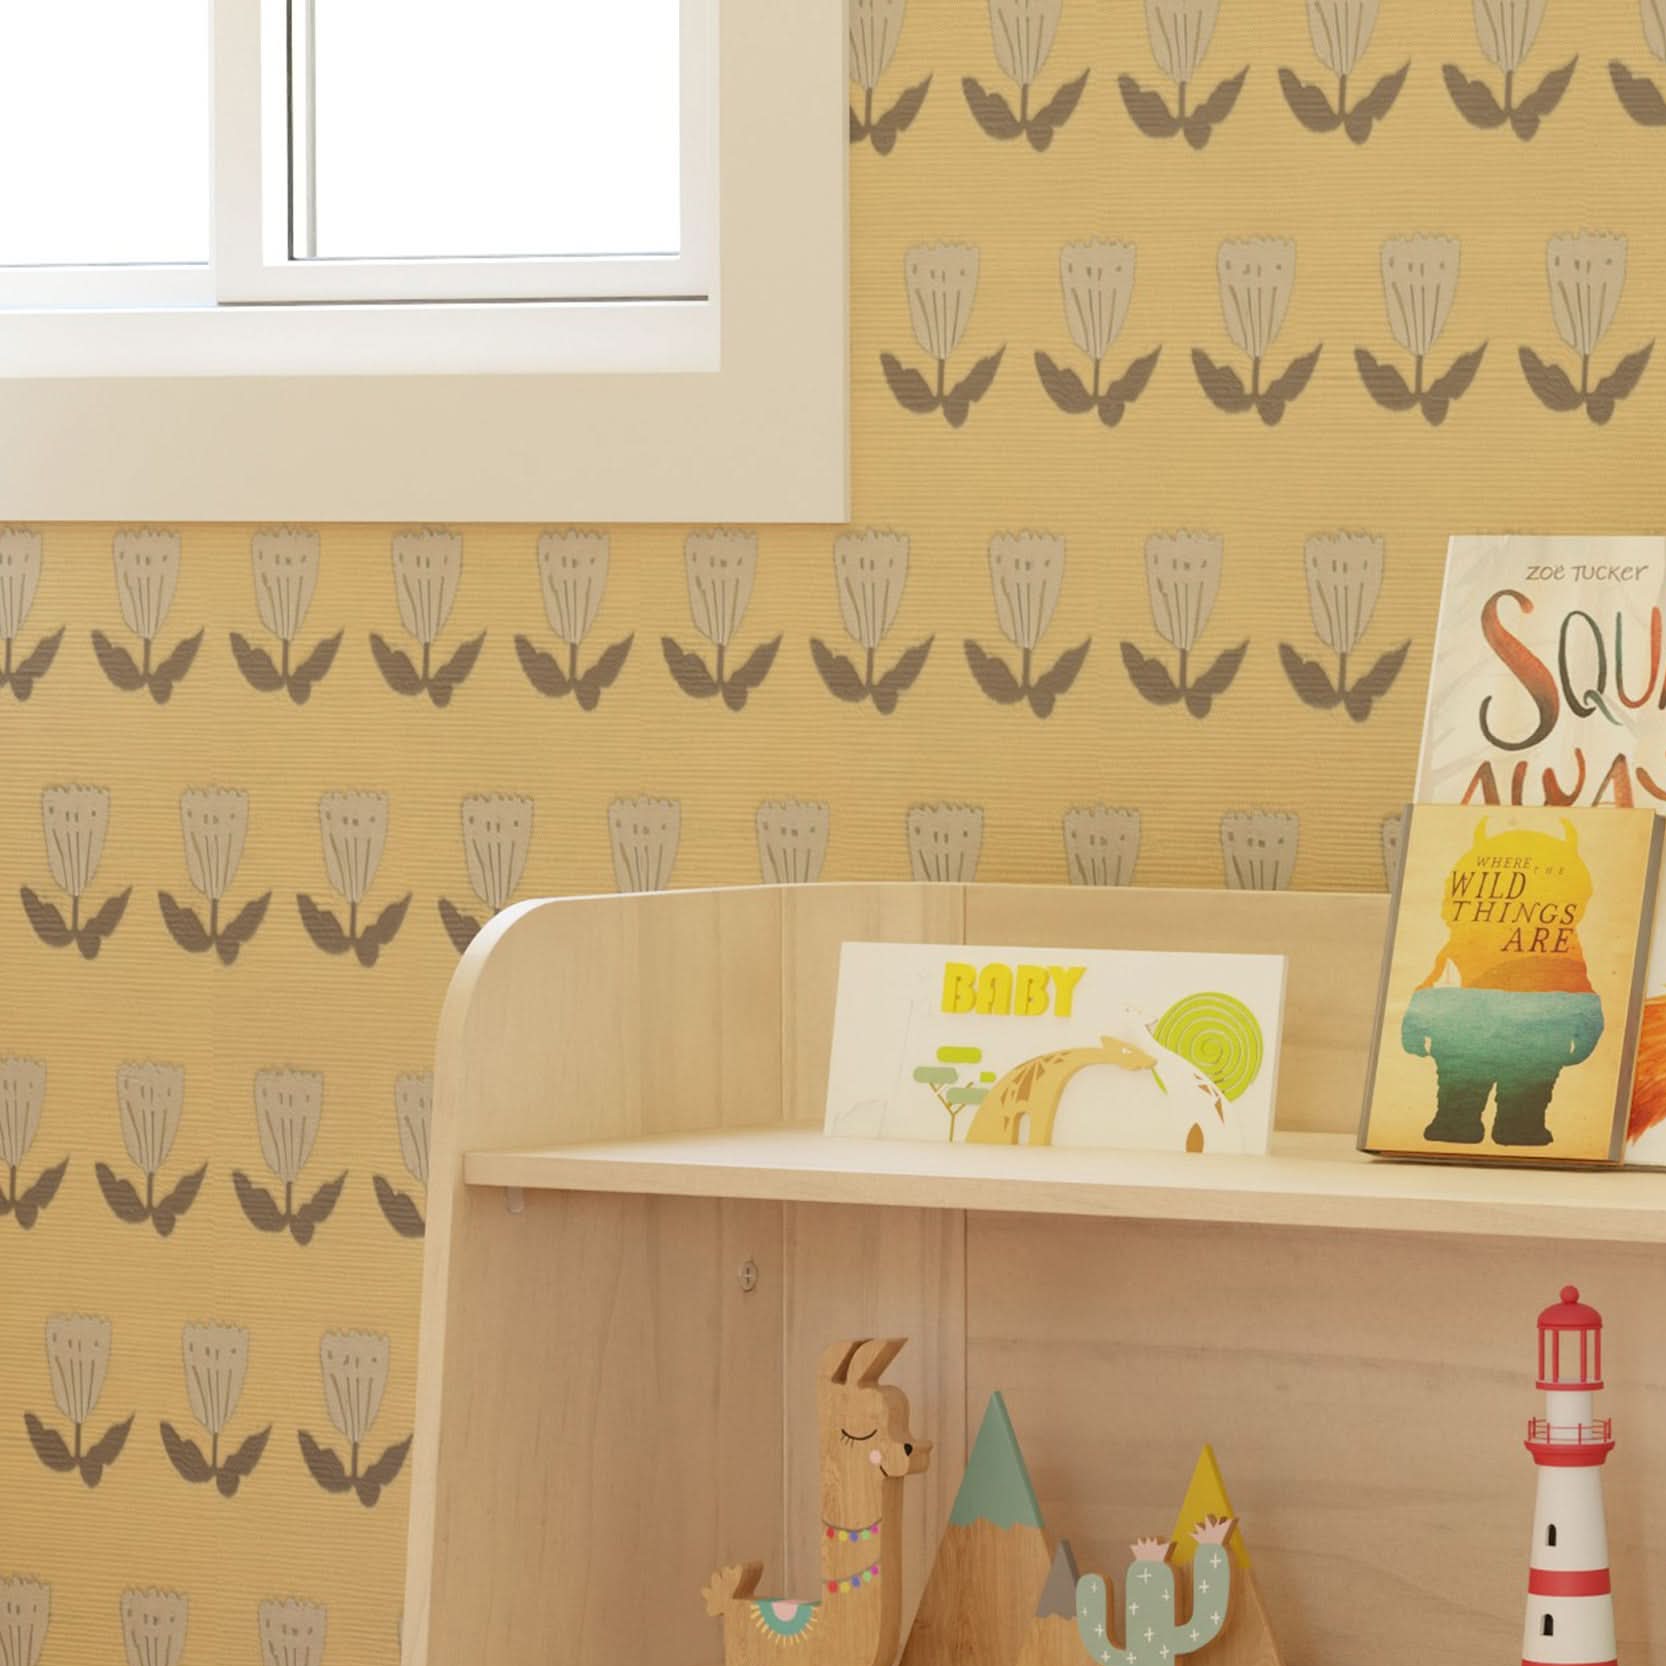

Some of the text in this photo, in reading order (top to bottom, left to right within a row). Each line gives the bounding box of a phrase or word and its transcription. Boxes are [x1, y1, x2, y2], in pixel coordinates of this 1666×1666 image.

[1476, 855, 1533, 870] WHERE
[1451, 871, 1527, 900] WILD
[1452, 900, 1578, 926] THINGS
[1500, 927, 1575, 953] ARE
[941, 962, 1088, 1018] BABY
